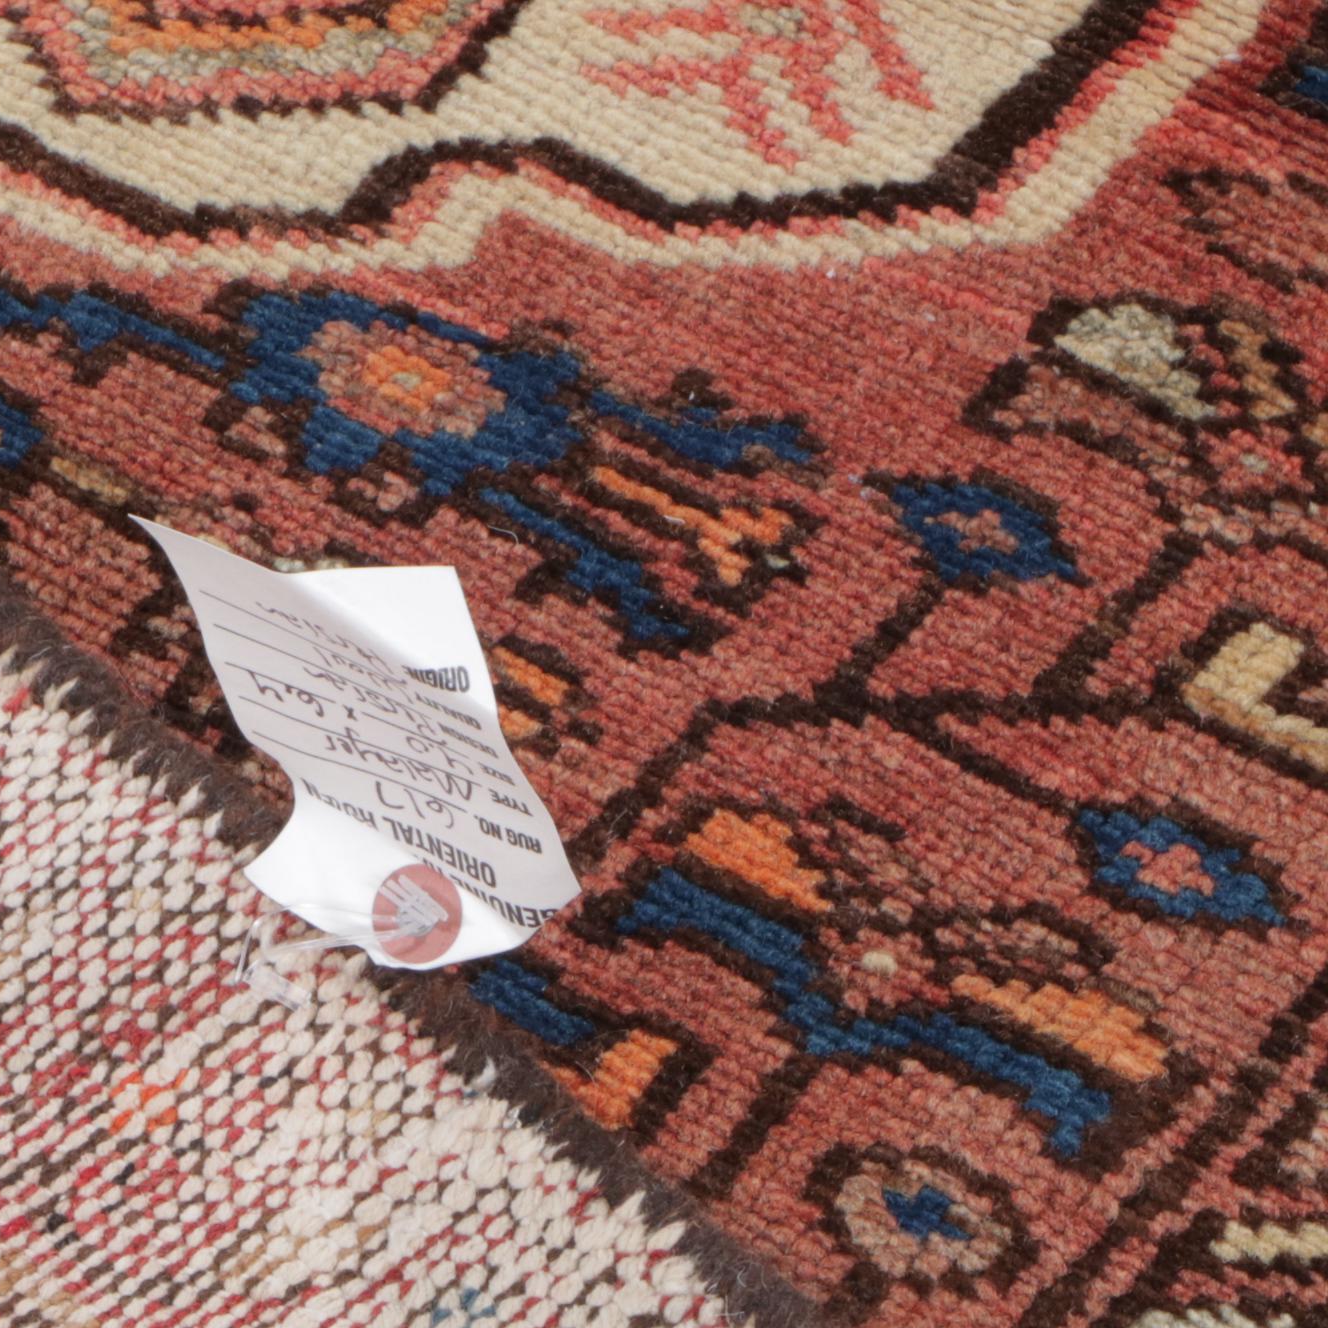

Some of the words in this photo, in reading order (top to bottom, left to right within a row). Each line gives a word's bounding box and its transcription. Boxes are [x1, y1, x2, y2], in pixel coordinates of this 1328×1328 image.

[374, 780, 455, 829] 617
[488, 788, 534, 817] TYPE
[472, 814, 503, 840] NO.
[506, 828, 543, 854] RUG
[382, 815, 497, 888] ORIENTAL
